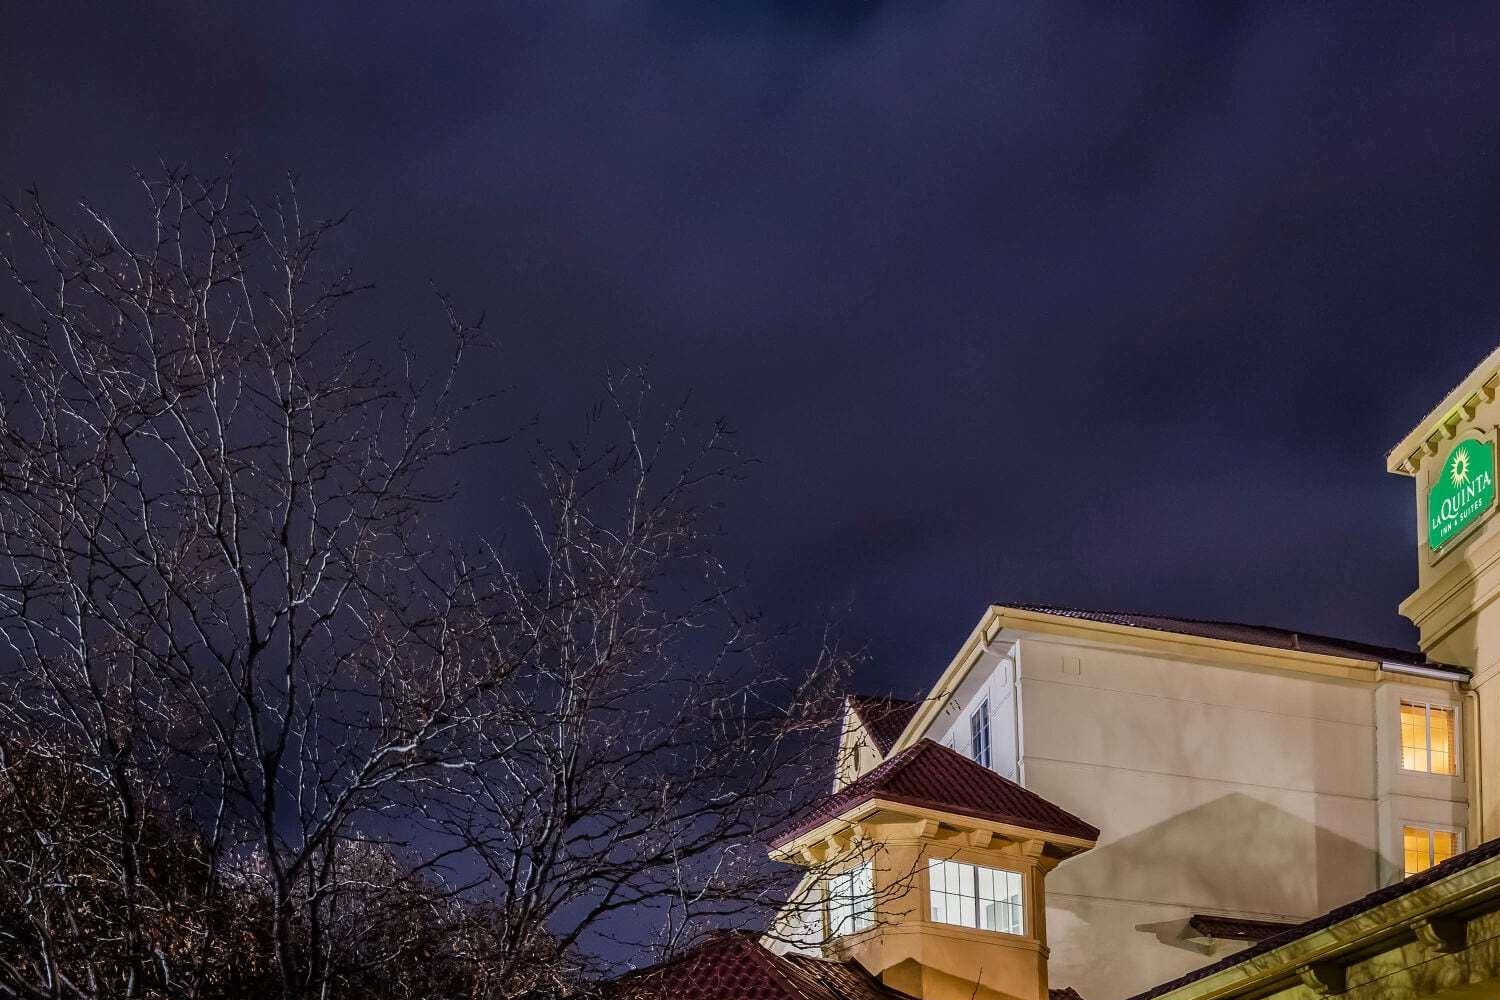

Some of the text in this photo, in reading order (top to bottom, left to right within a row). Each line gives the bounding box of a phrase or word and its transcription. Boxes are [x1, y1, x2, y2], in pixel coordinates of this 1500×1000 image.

[1432, 471, 1491, 530] LA QUINTA
[1440, 522, 1452, 538] INN
[1460, 497, 1482, 522] SUITES
